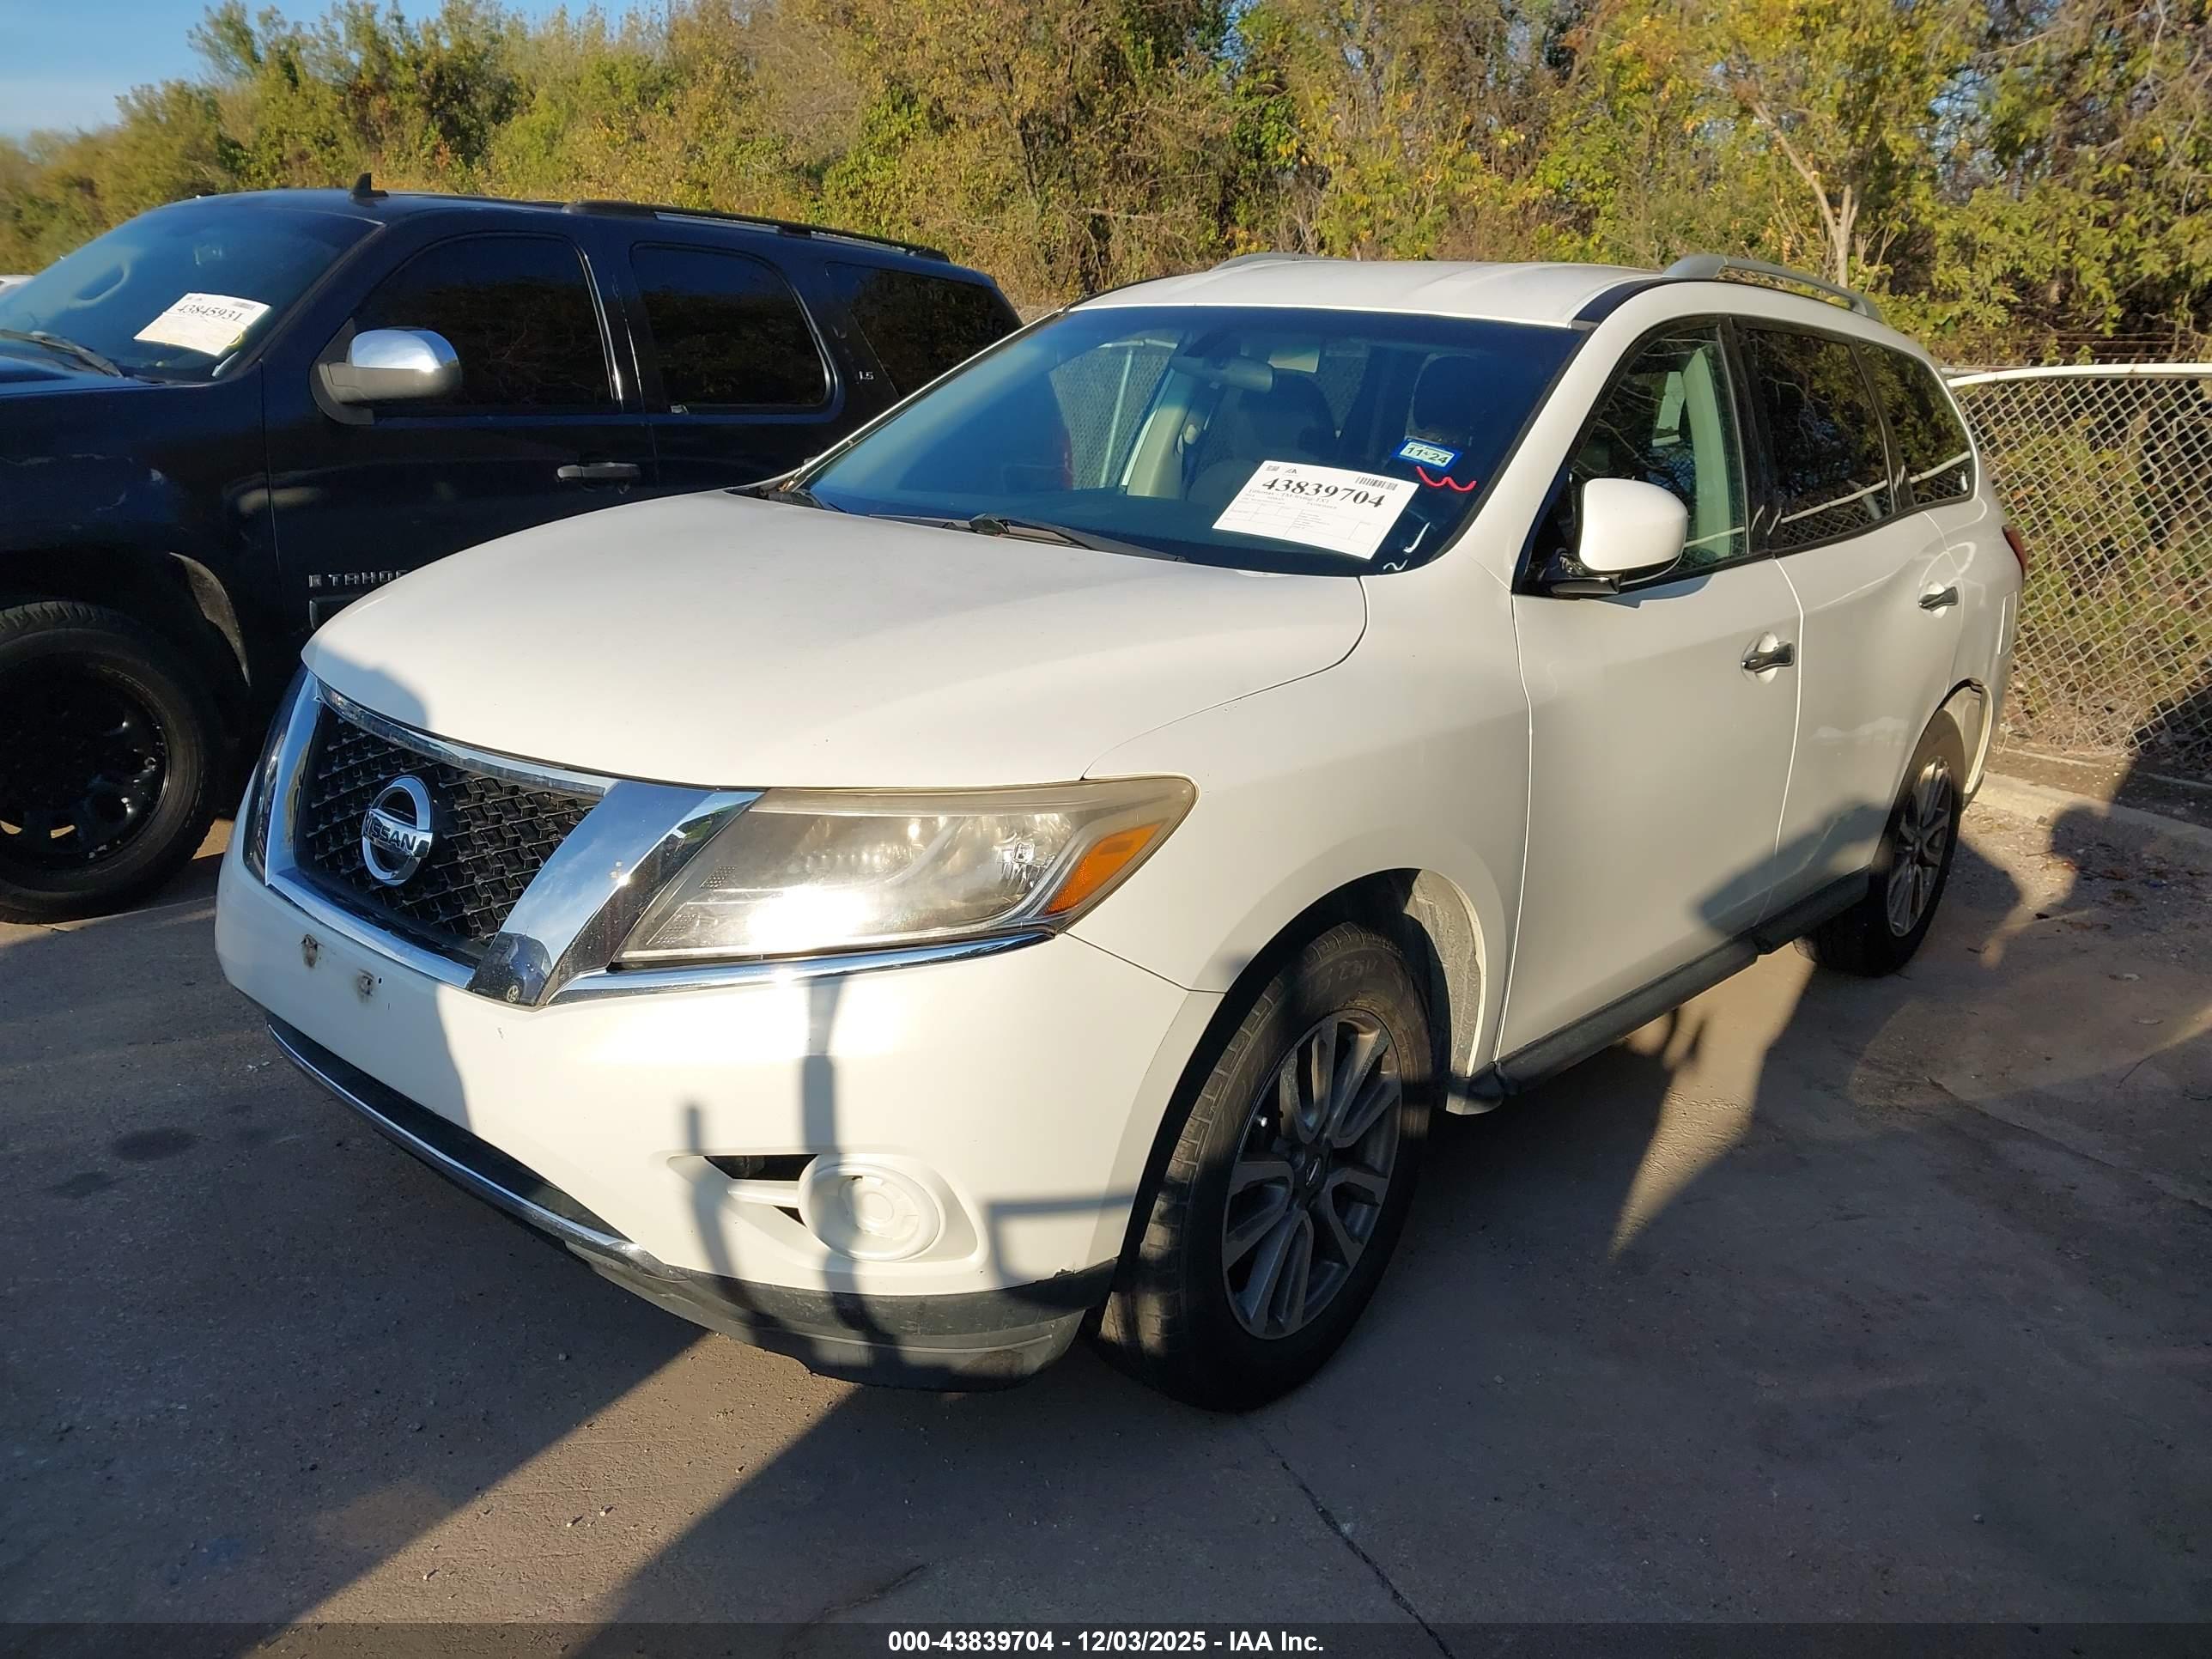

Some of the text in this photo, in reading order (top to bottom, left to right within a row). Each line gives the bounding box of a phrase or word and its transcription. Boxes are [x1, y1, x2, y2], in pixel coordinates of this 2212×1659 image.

[177, 304, 243, 321] 43845931
[1261, 477, 1385, 507] 43839704
[364, 815, 417, 851] NISSAN
